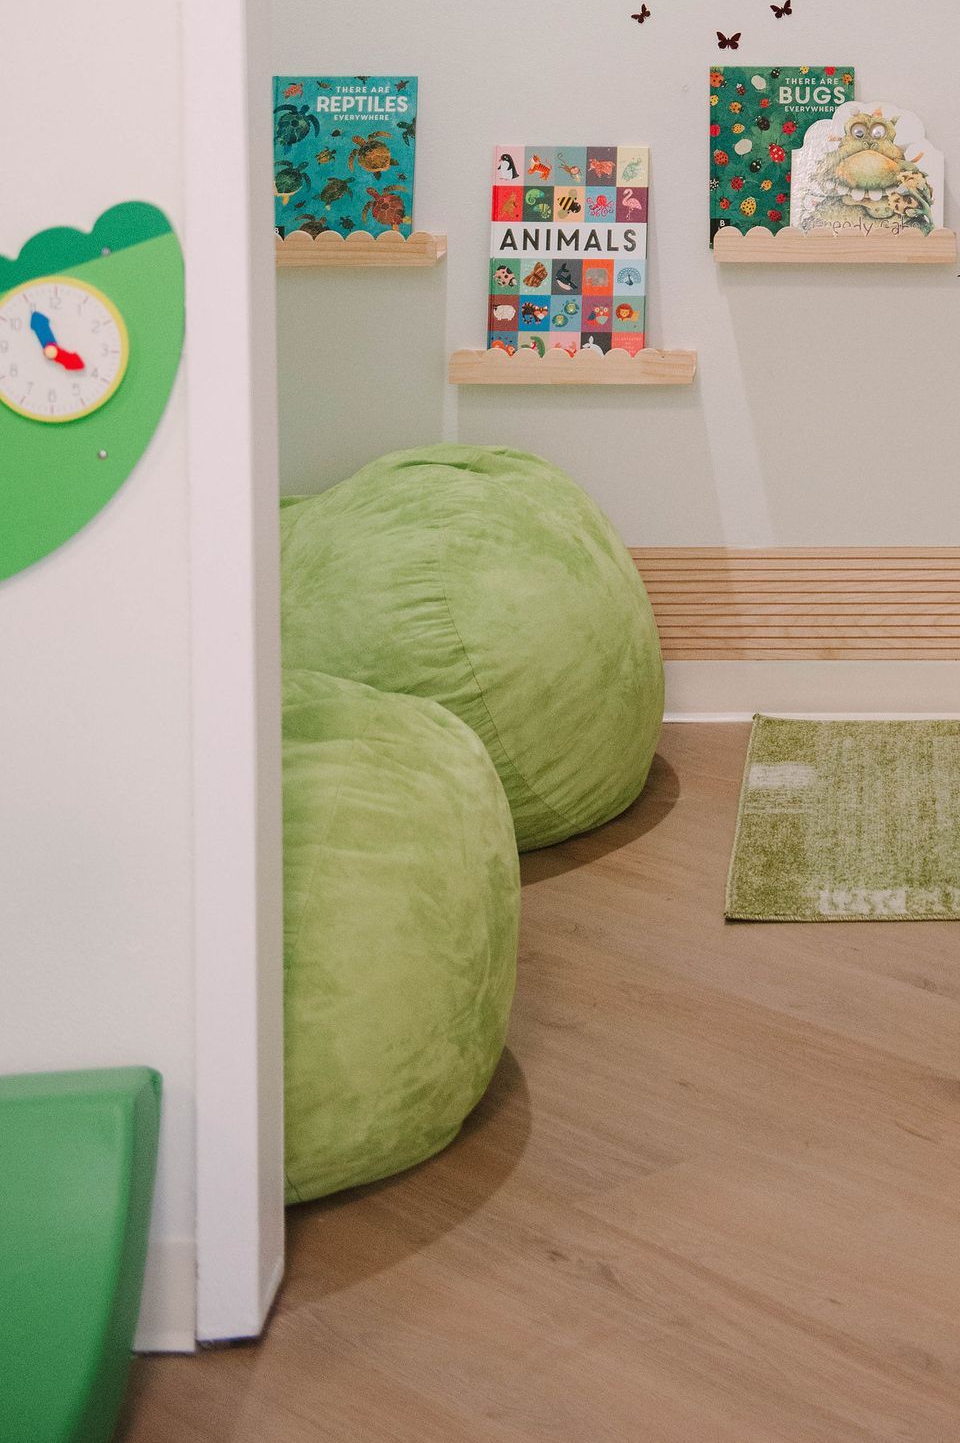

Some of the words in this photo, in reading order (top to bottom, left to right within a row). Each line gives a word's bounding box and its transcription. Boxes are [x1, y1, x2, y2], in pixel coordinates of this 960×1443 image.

[336, 86, 368, 94] THERE
[371, 86, 391, 94] ARE
[779, 86, 846, 104] BUGS
[316, 96, 409, 113] REPTILES
[499, 228, 638, 252] ANIMALS
